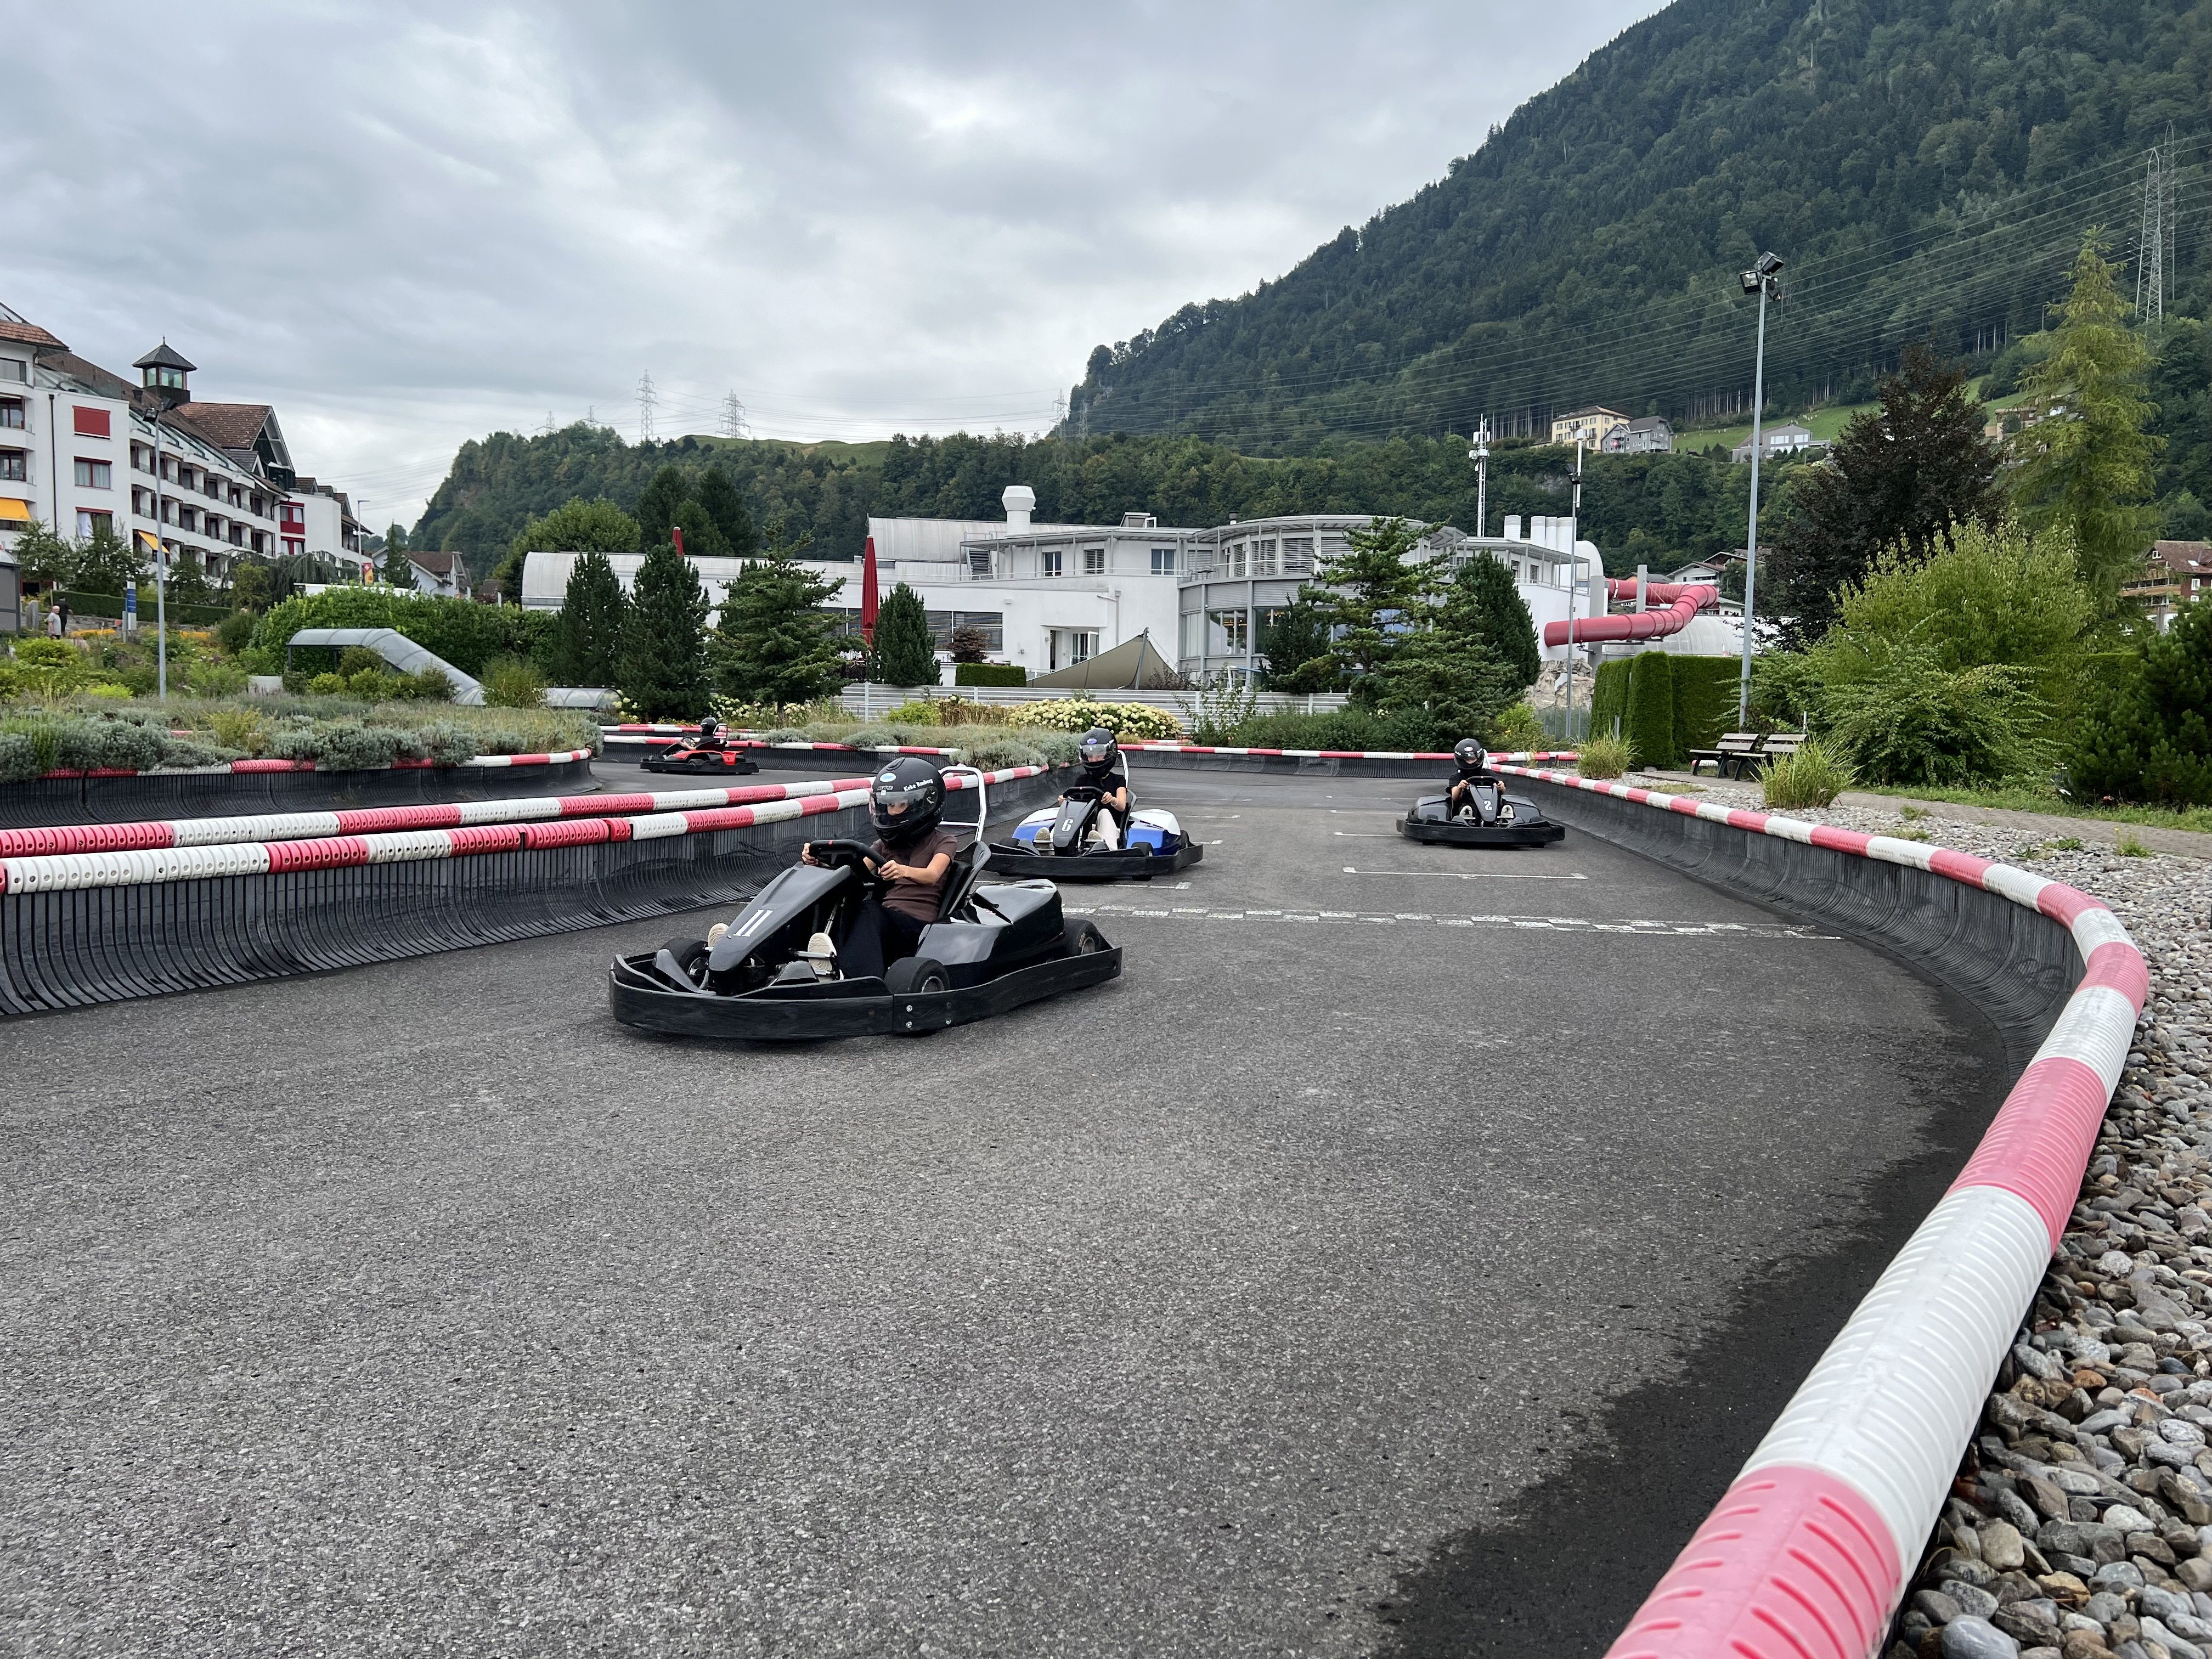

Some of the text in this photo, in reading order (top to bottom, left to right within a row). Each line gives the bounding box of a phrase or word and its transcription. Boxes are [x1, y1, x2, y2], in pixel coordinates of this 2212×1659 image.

[1483, 800, 1492, 810] 2
[1061, 819, 1074, 832] 6
[733, 910, 773, 937] 11
